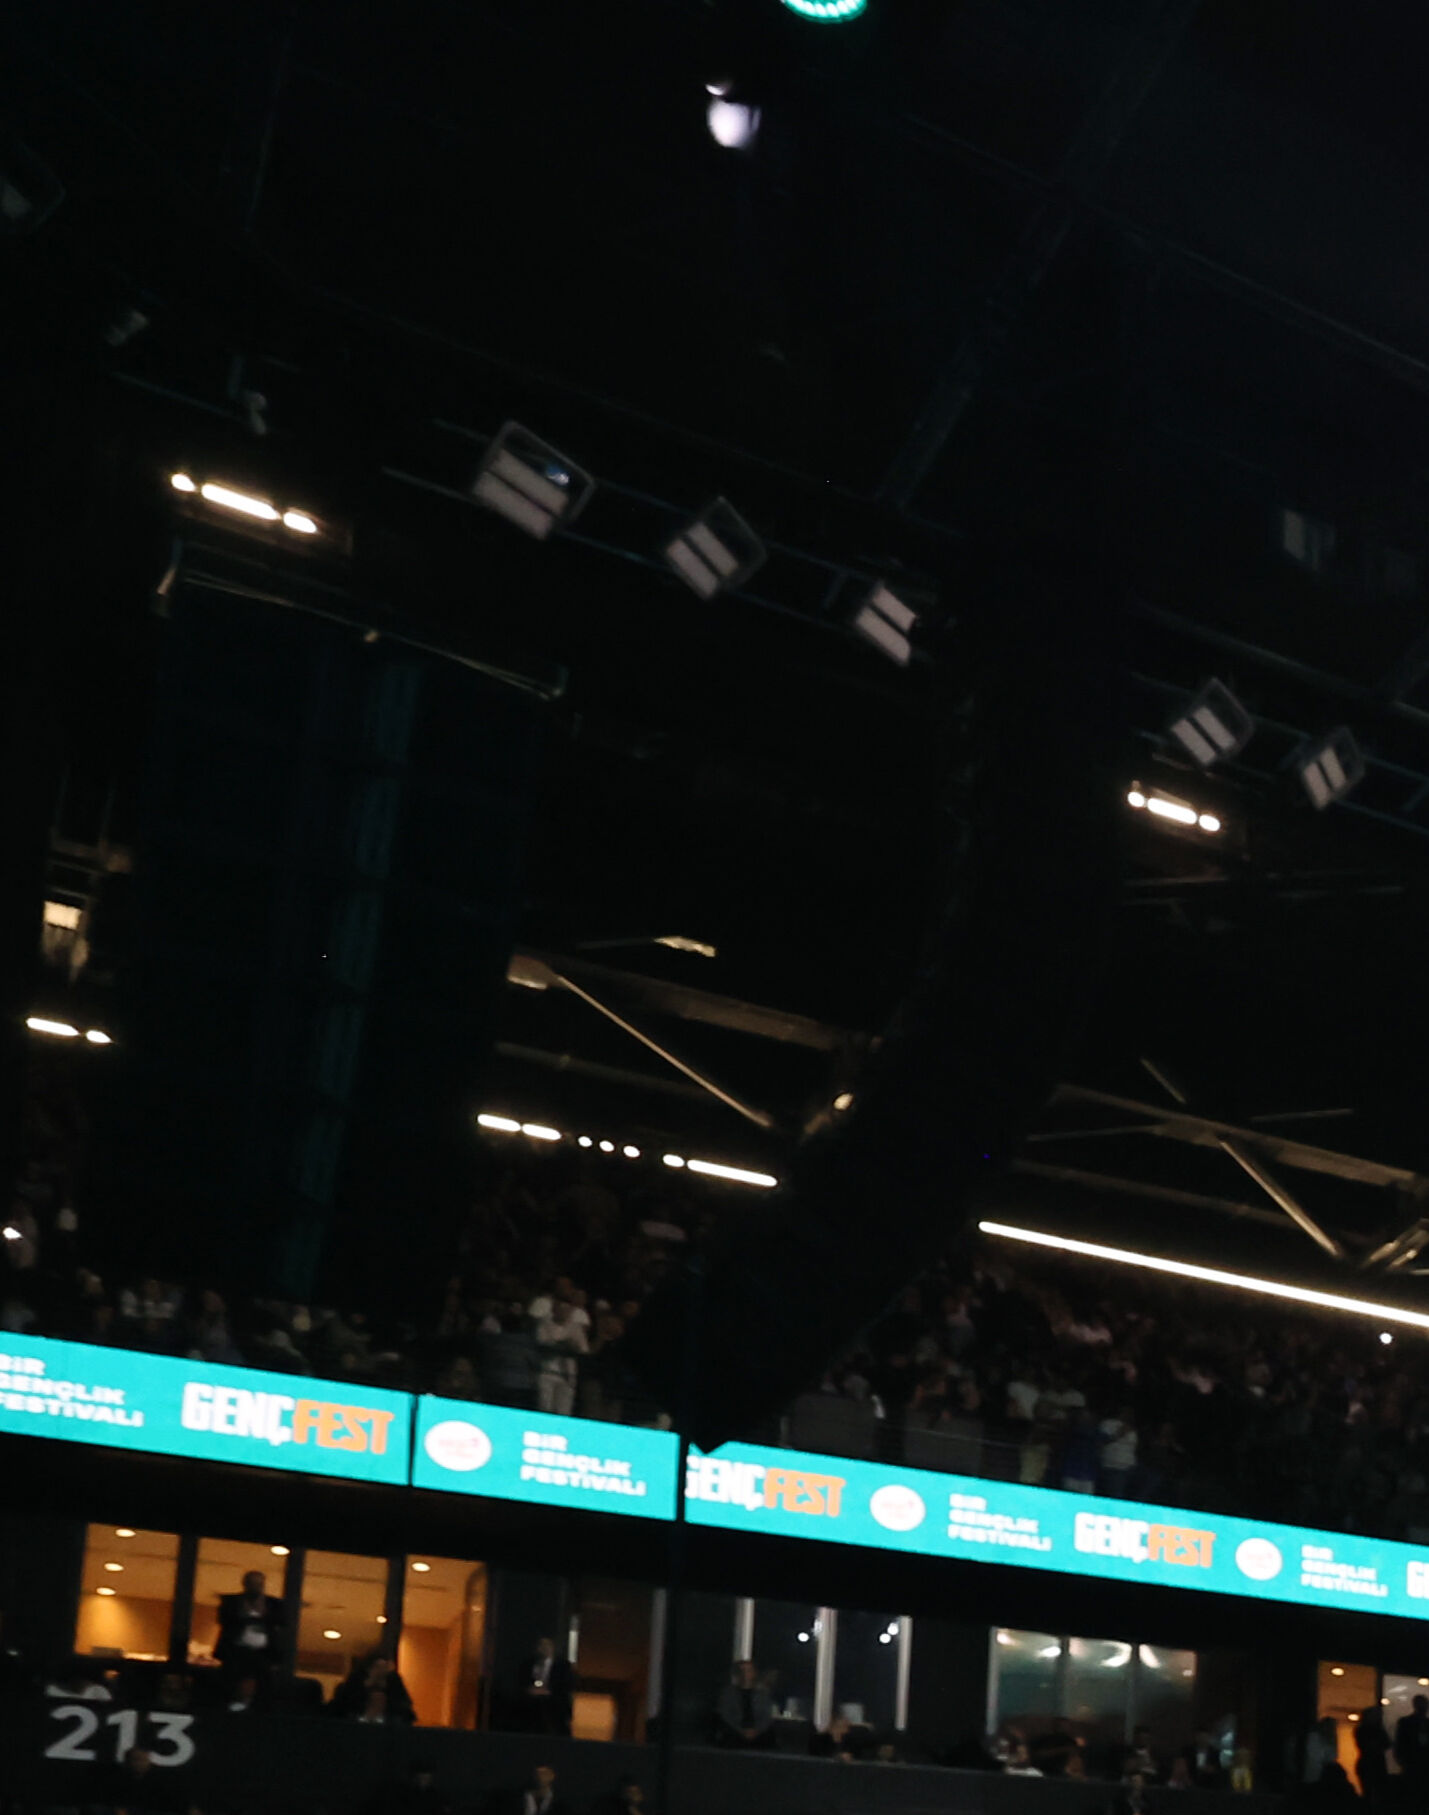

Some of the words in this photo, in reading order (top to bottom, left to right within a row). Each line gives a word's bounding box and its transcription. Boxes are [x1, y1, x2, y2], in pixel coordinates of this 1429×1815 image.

[181, 1381, 394, 1454] GENÇFEST
[1074, 1511, 1216, 1568] GENÇFEST
[45, 1704, 195, 1767] 213
